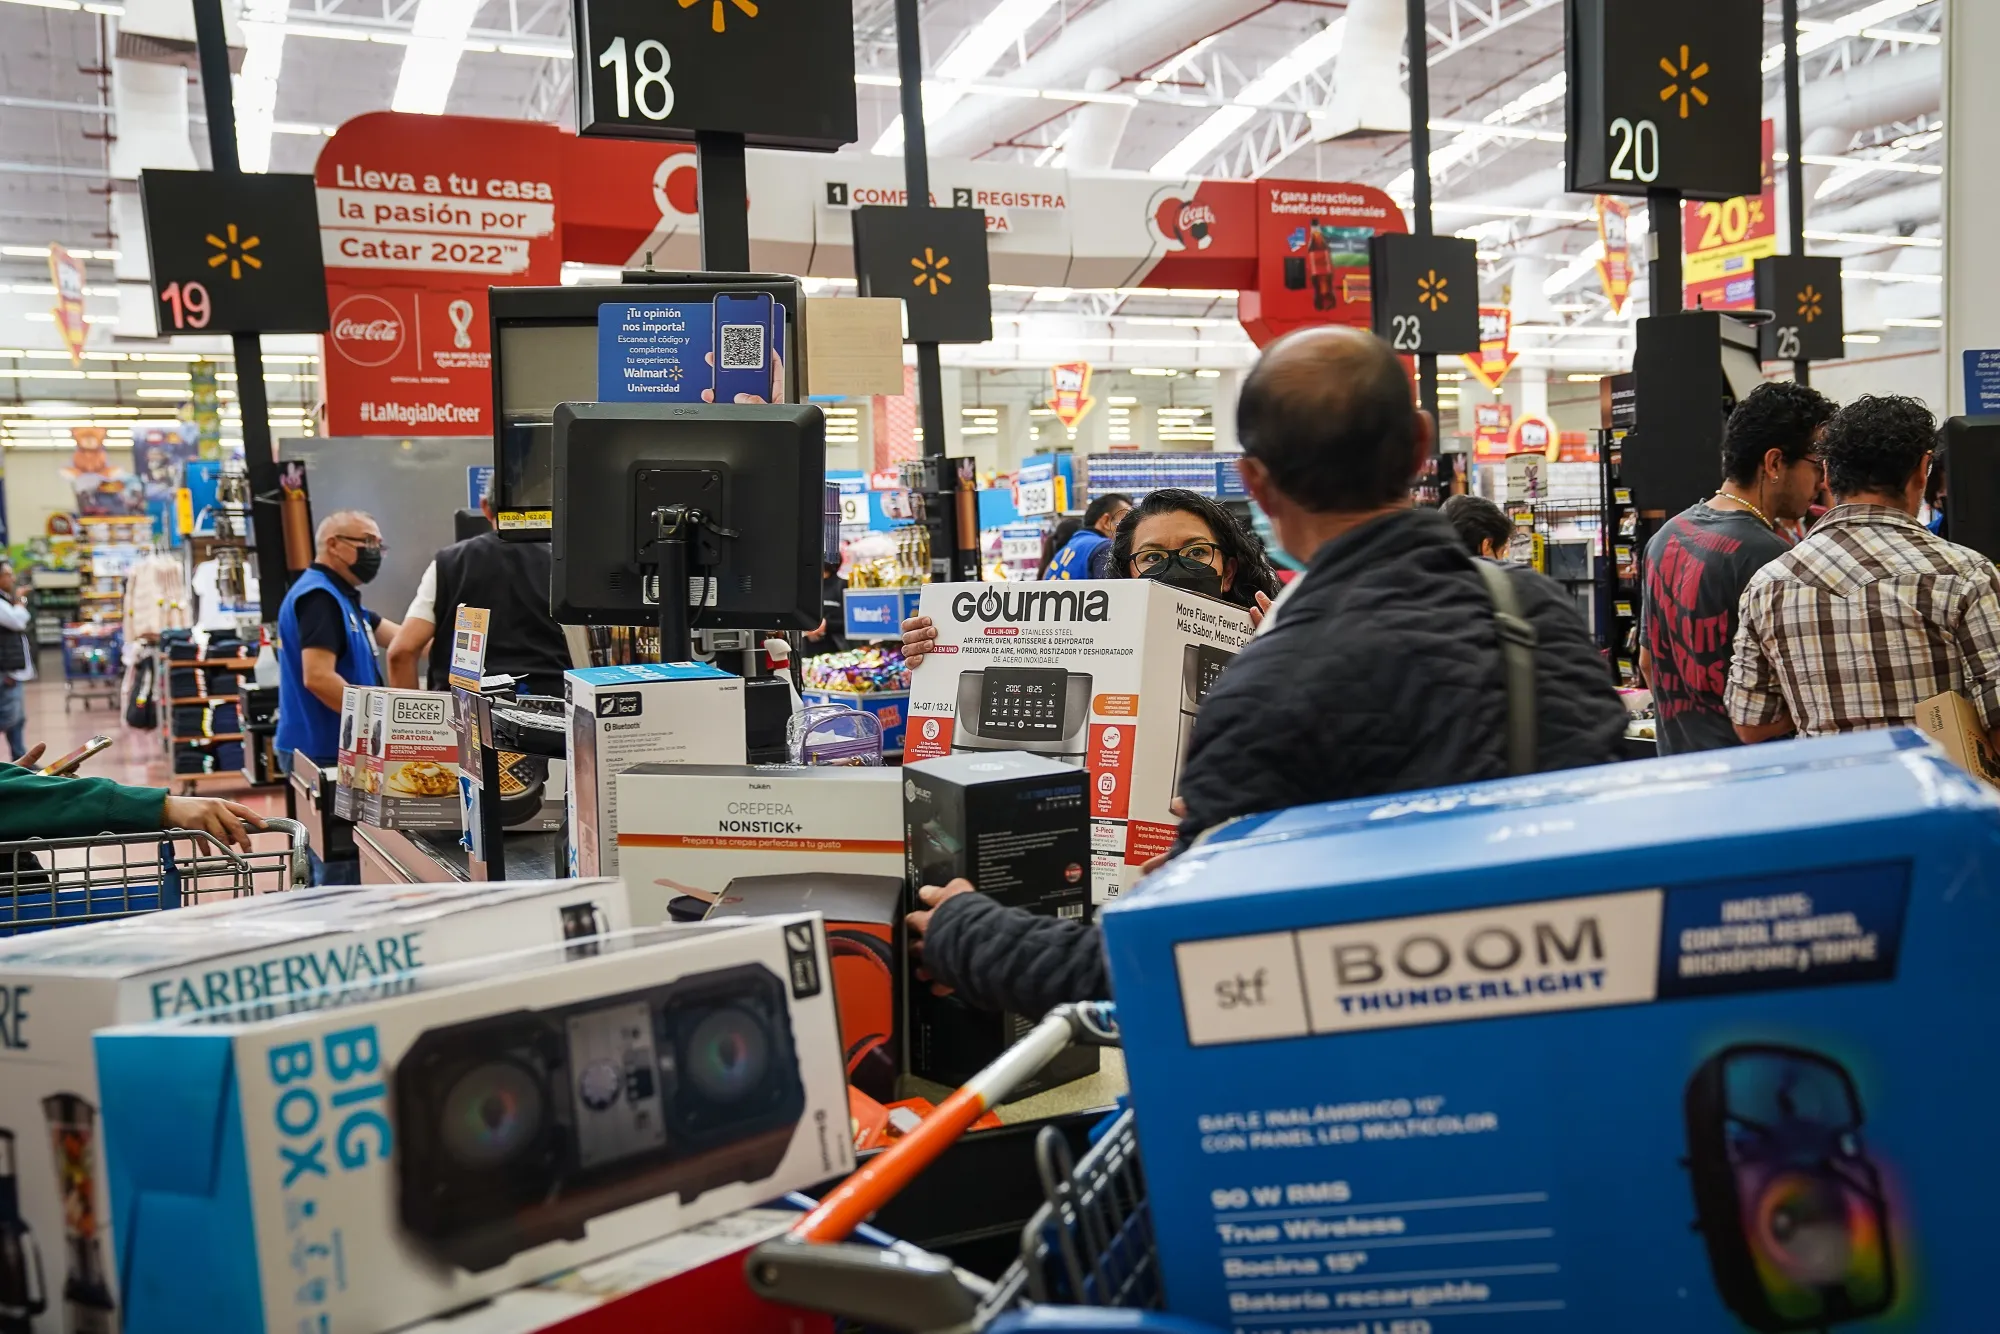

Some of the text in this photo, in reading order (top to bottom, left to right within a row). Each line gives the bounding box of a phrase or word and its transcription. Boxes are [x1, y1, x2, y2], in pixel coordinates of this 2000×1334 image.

[600, 36, 674, 120] 18
[1609, 117, 1659, 182] 20
[336, 164, 554, 200] Lleva a tu casa
[832, 186, 842, 202] 1
[956, 191, 969, 207] 2
[977, 192, 1066, 209] REGISTRA
[1271, 189, 1364, 206] Y gana atractivos
[338, 198, 527, 232] la pasión por
[1272, 202, 1387, 218] beneficios semanales
[1698, 195, 1765, 250] 20%
[339, 238, 422, 261] Catar
[161, 281, 211, 328] 19
[626, 308, 681, 320] ¡Tu opinión
[617, 335, 648, 343] Escanea
[649, 335, 656, 343] el
[658, 335, 683, 344] código
[623, 322, 685, 334] nos importa!
[1392, 315, 1421, 350] 23
[629, 346, 678, 355] compártenos
[1777, 327, 1800, 358] 25
[624, 368, 668, 378] Walmart
[627, 383, 680, 392] Universidad
[360, 402, 481, 426] #LaMagiaDeCreer
[1176, 602, 1256, 636] More Flavor, Fewer Calor
[974, 637, 994, 645] FRYER,
[995, 637, 1012, 645] OVEN,
[1013, 637, 1046, 645] ROTISSERIE
[1054, 637, 1094, 645] DEHYDRATOR
[1177, 619, 1236, 646] Más Sabor, Menos
[1000, 647, 1015, 655] AIRE,
[1084, 648, 1134, 656] DESHIDRATADOR
[1023, 656, 1059, 664] INOXIDABLE
[1026, 685, 1043, 693] 18:25
[398, 702, 440, 711] BLACK+
[398, 711, 440, 720] DECKER
[619, 704, 638, 713] leaf
[913, 702, 931, 710] 14-QT
[936, 702, 948, 711] 13.2
[612, 722, 641, 730] Bluetooth
[727, 802, 793, 816] CREPERA
[719, 820, 803, 834] NONSTICK+
[682, 836, 713, 847] Prepara
[758, 839, 799, 849] perfectas
[807, 840, 816, 848] tu
[817, 841, 841, 851] gusto
[1680, 923, 1770, 951] CONTROL
[1330, 917, 1606, 987] BOOM
[150, 931, 425, 1019] FARBERWARE
[1214, 967, 1269, 1010] stf
[1335, 969, 1608, 1014] THUNDERLIGHT
[323, 1024, 393, 1172] BIG
[267, 1040, 329, 1190] BOX
[1201, 1112, 1498, 1154] CON PANEL LED MULTICOLOR
[1251, 1186, 1281, 1207] W
[1286, 1180, 1351, 1203] RMS
[1216, 1216, 1405, 1244] True Wireless
[1223, 1254, 1320, 1278] Bocina
[1335, 1281, 1490, 1308] recargable
